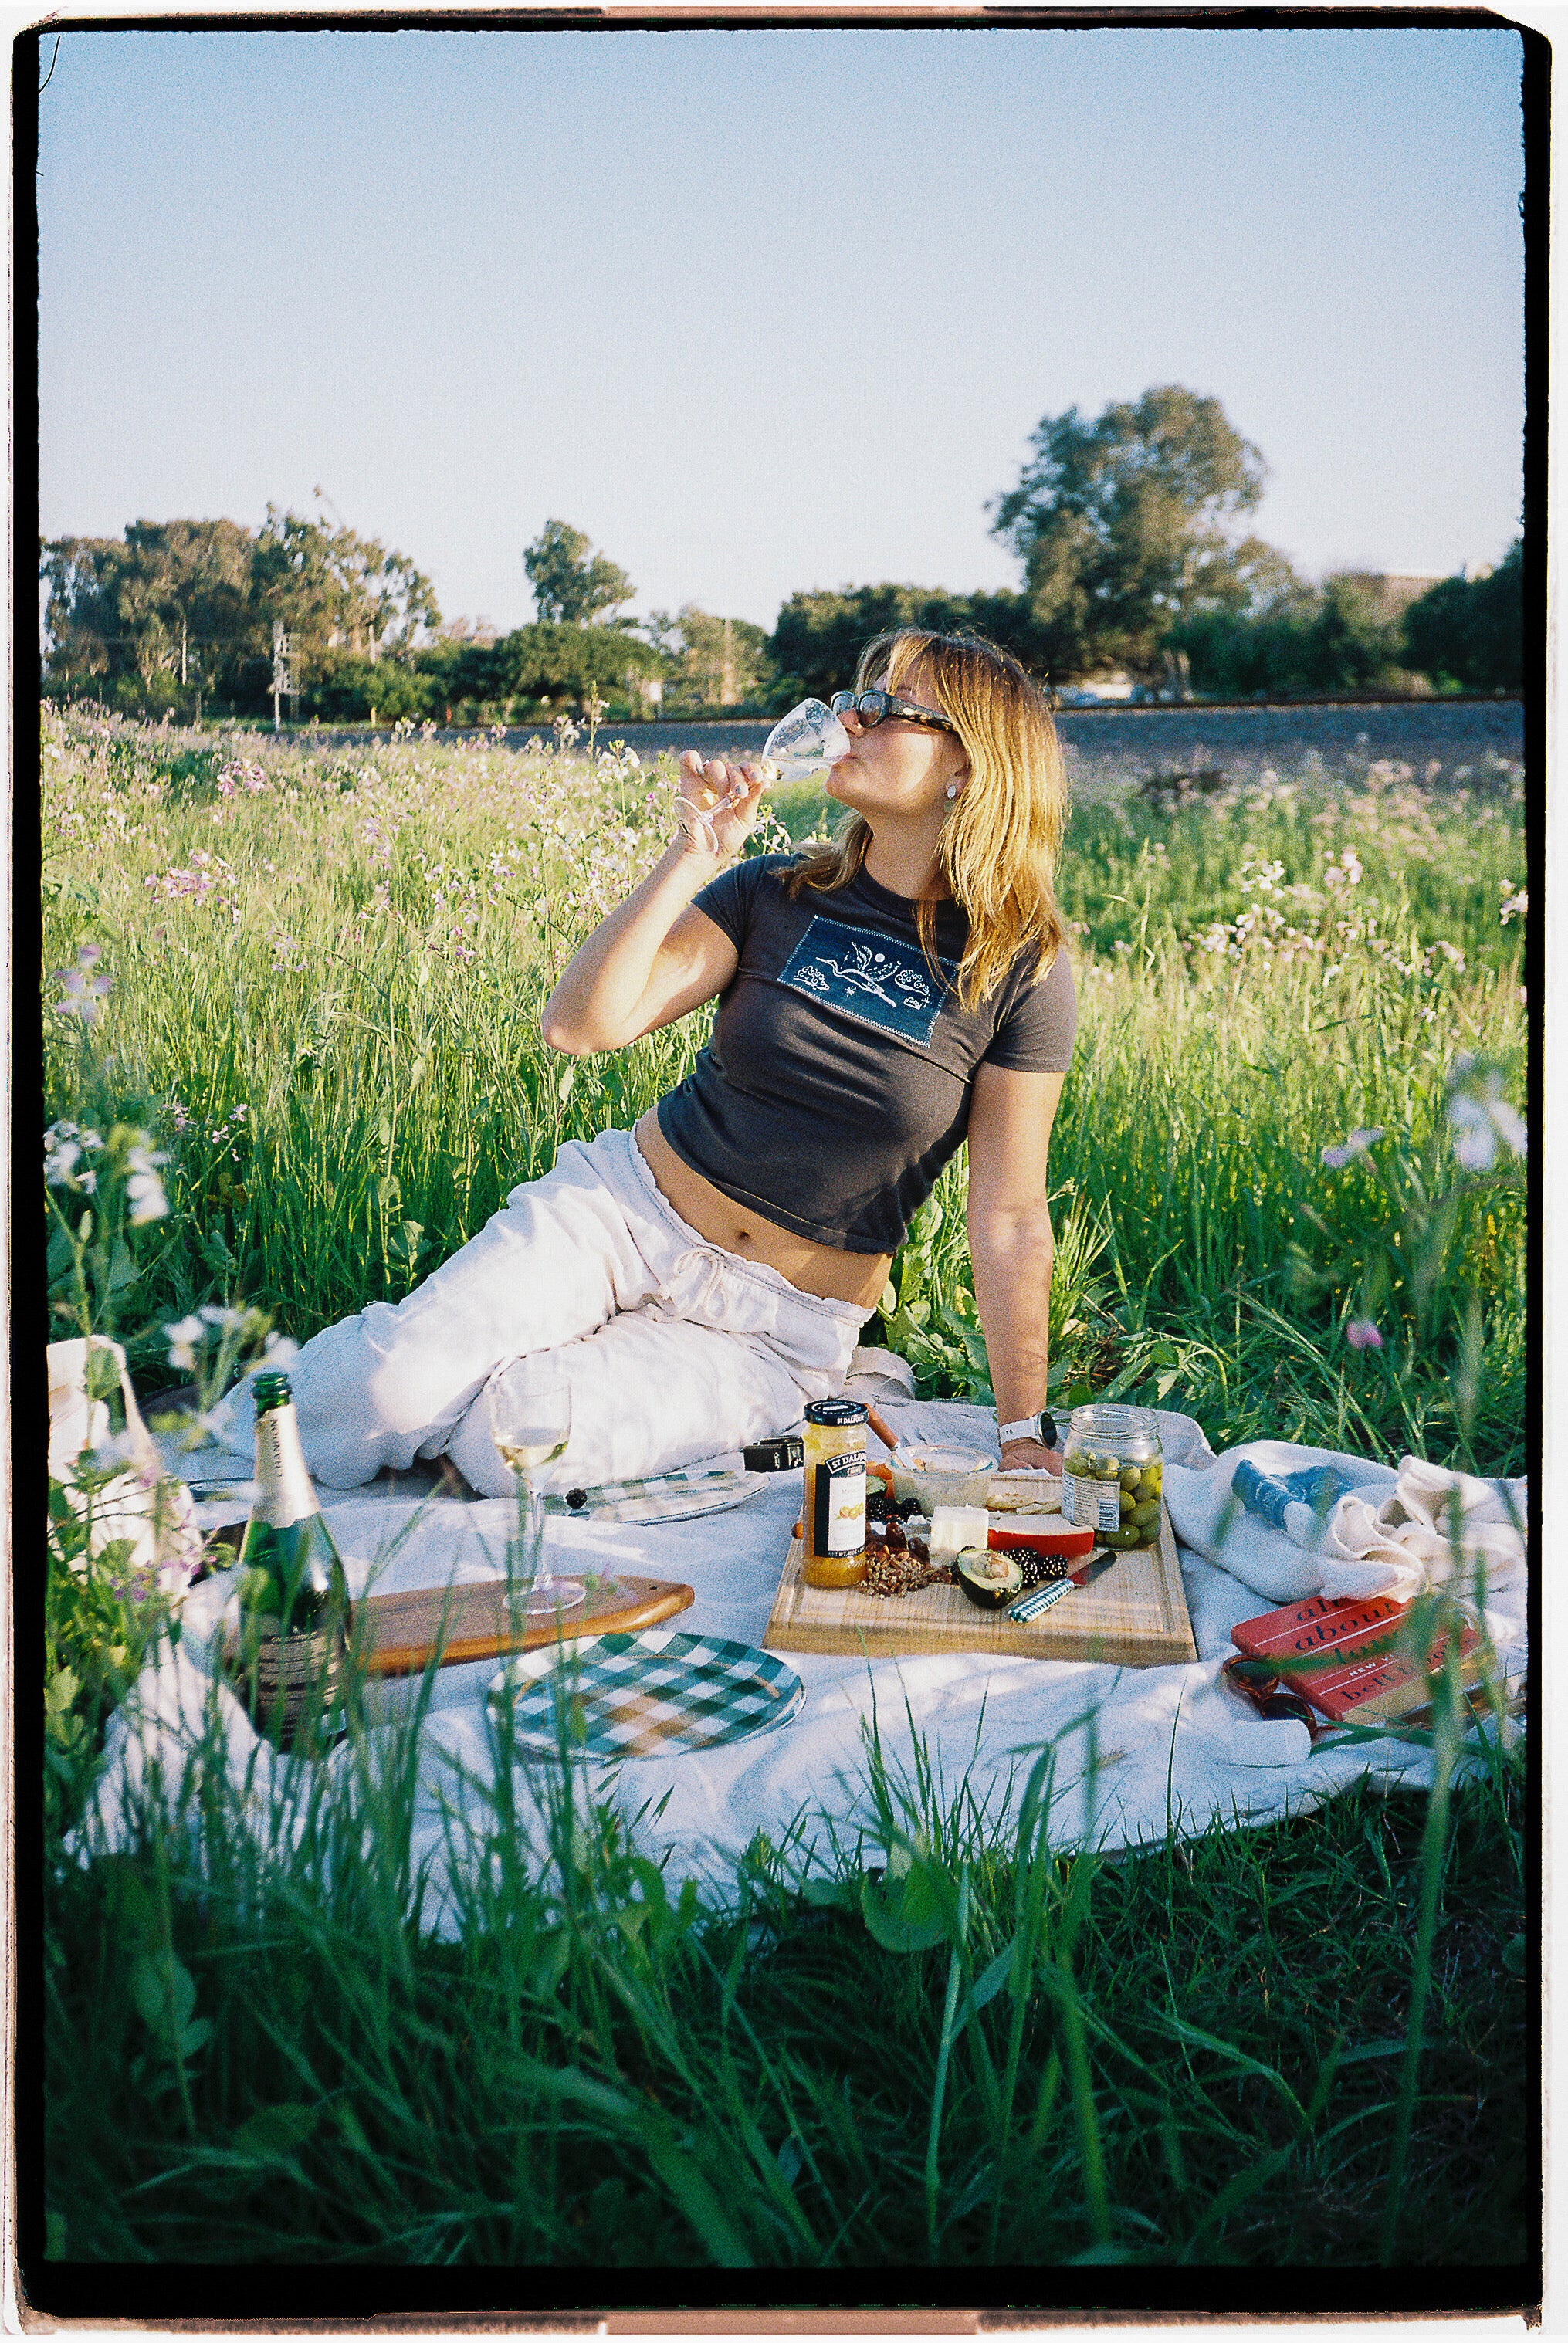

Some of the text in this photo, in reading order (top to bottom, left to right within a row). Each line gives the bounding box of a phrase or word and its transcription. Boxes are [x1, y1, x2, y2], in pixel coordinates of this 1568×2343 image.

[831, 1458, 842, 1468] ST
[1295, 1602, 1396, 1651] about
[1348, 1662, 1377, 1677] NEW
[1340, 1673, 1395, 1701] bell
